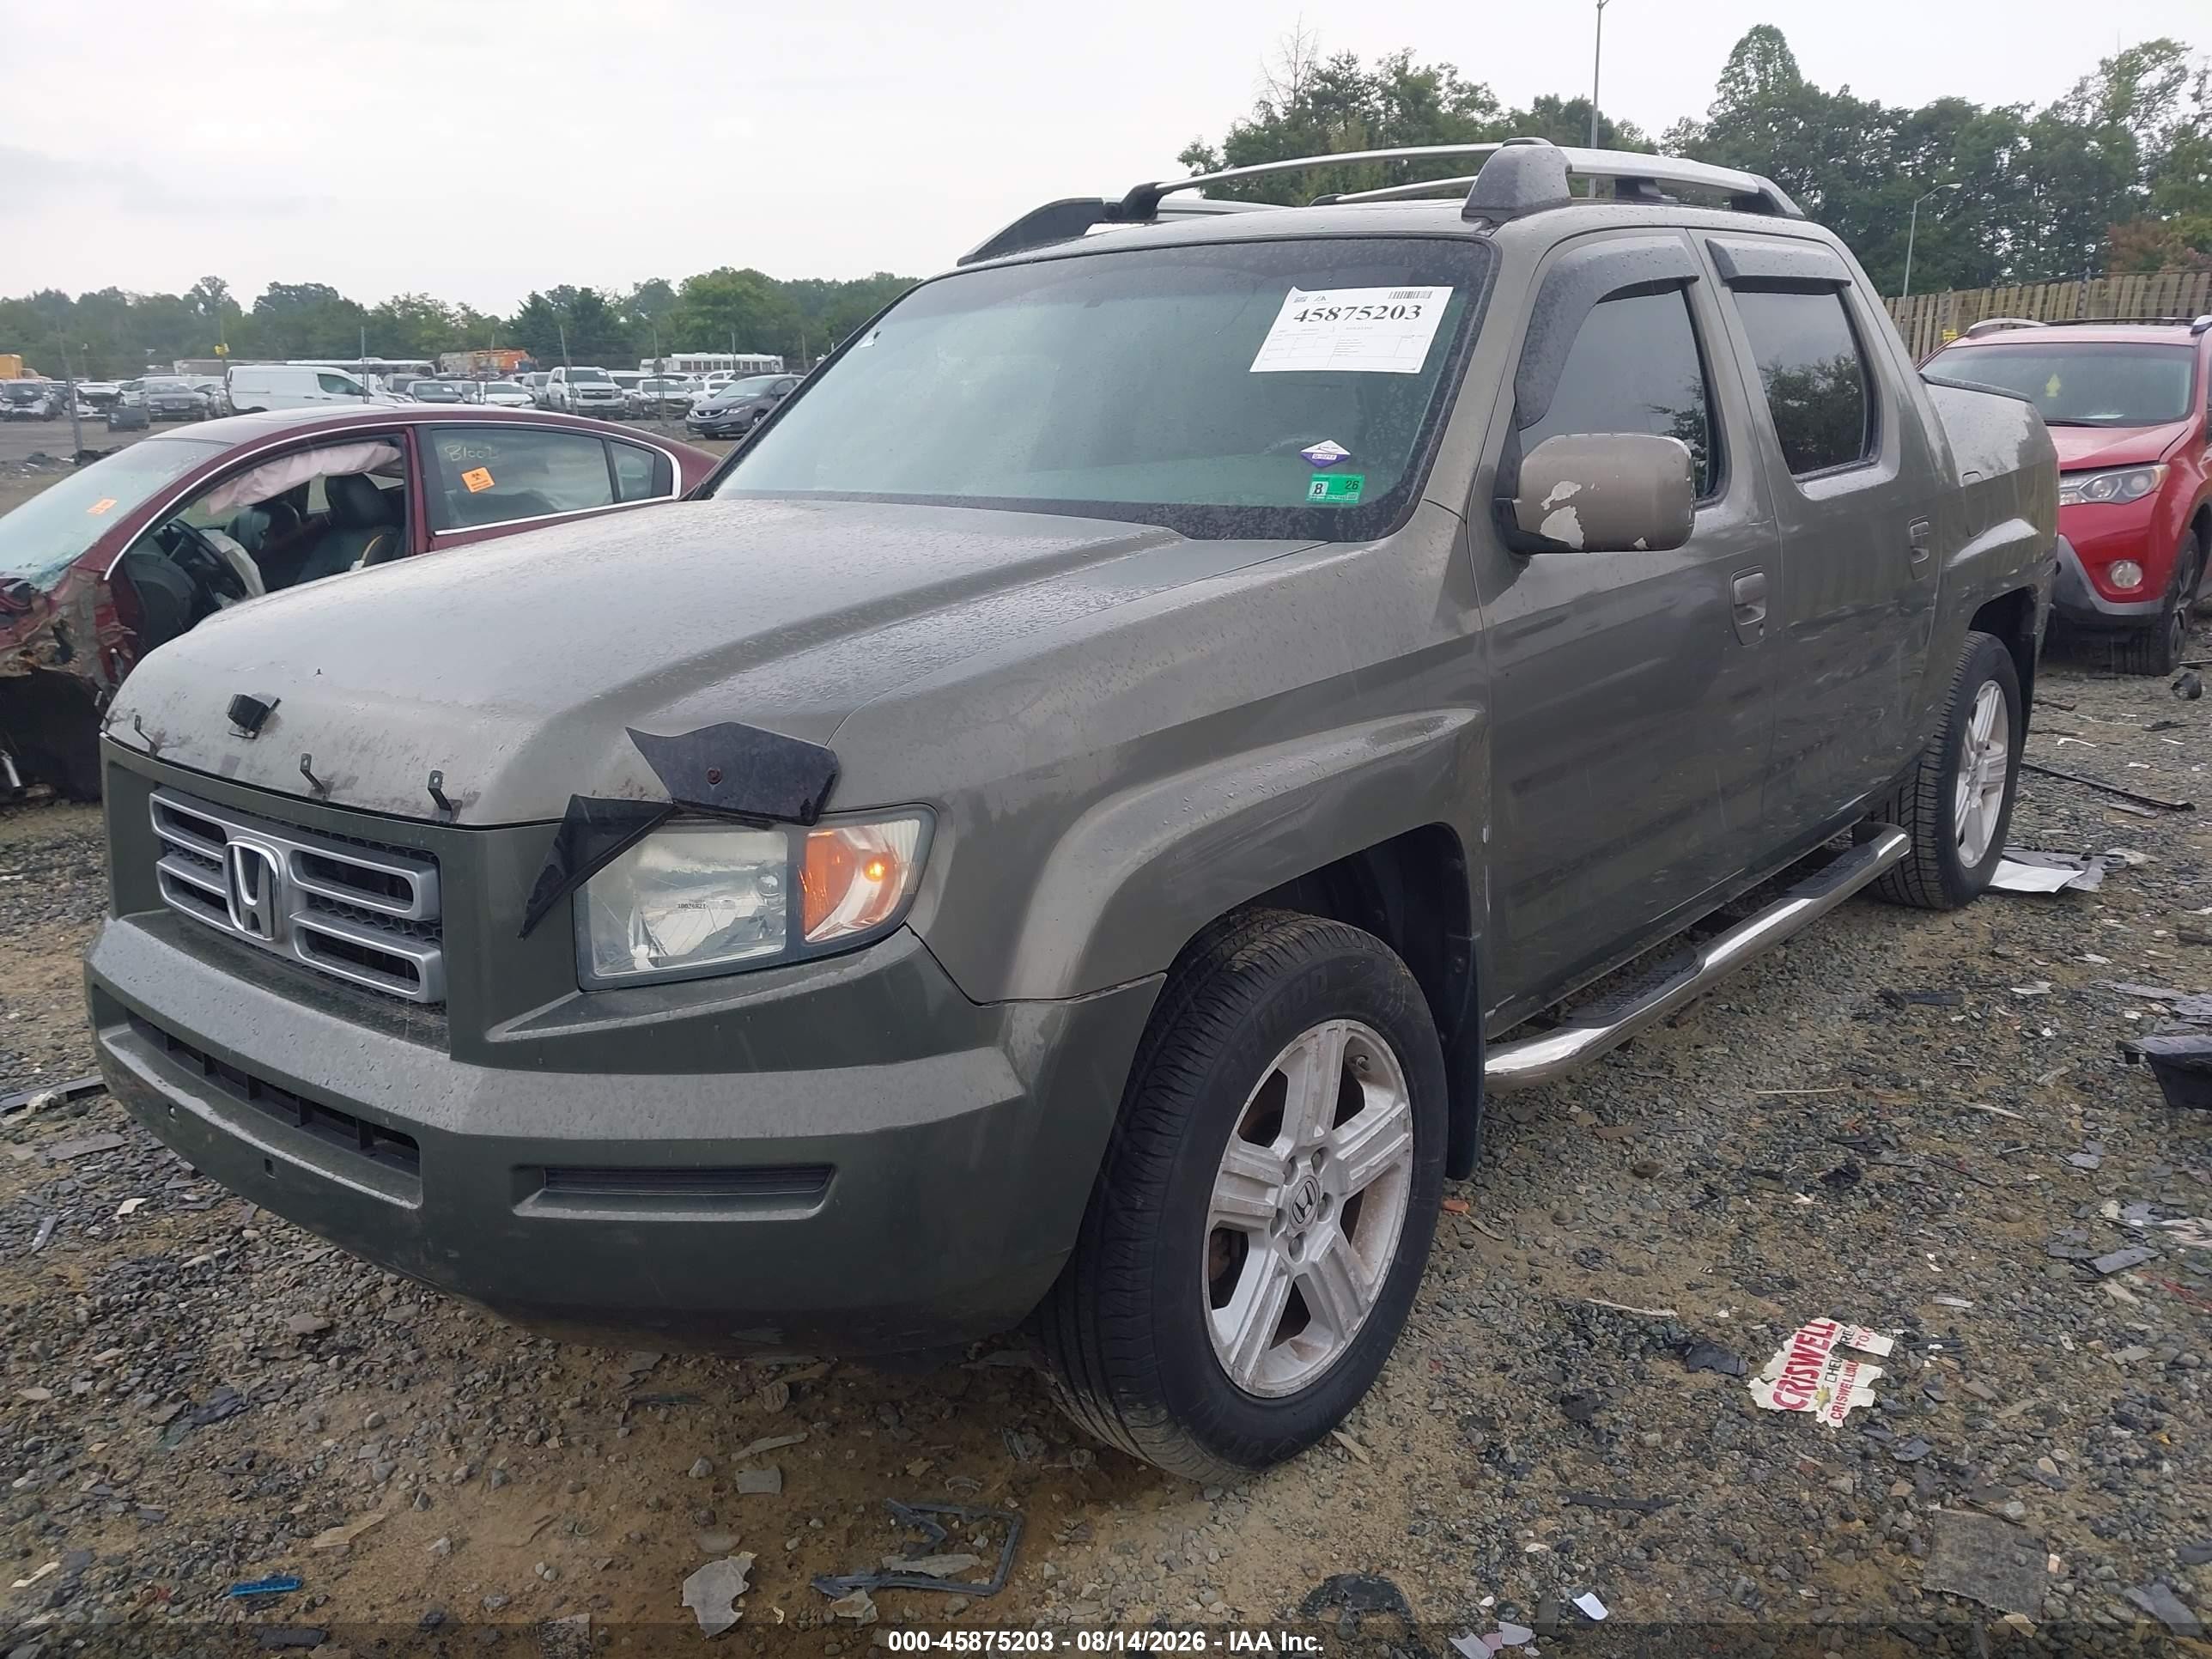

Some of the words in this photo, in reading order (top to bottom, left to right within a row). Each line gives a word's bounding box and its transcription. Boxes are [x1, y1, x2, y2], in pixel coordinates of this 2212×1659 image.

[1293, 304, 1423, 323] 45875203
[1313, 483, 1324, 495] 8
[1345, 479, 1359, 490] 26
